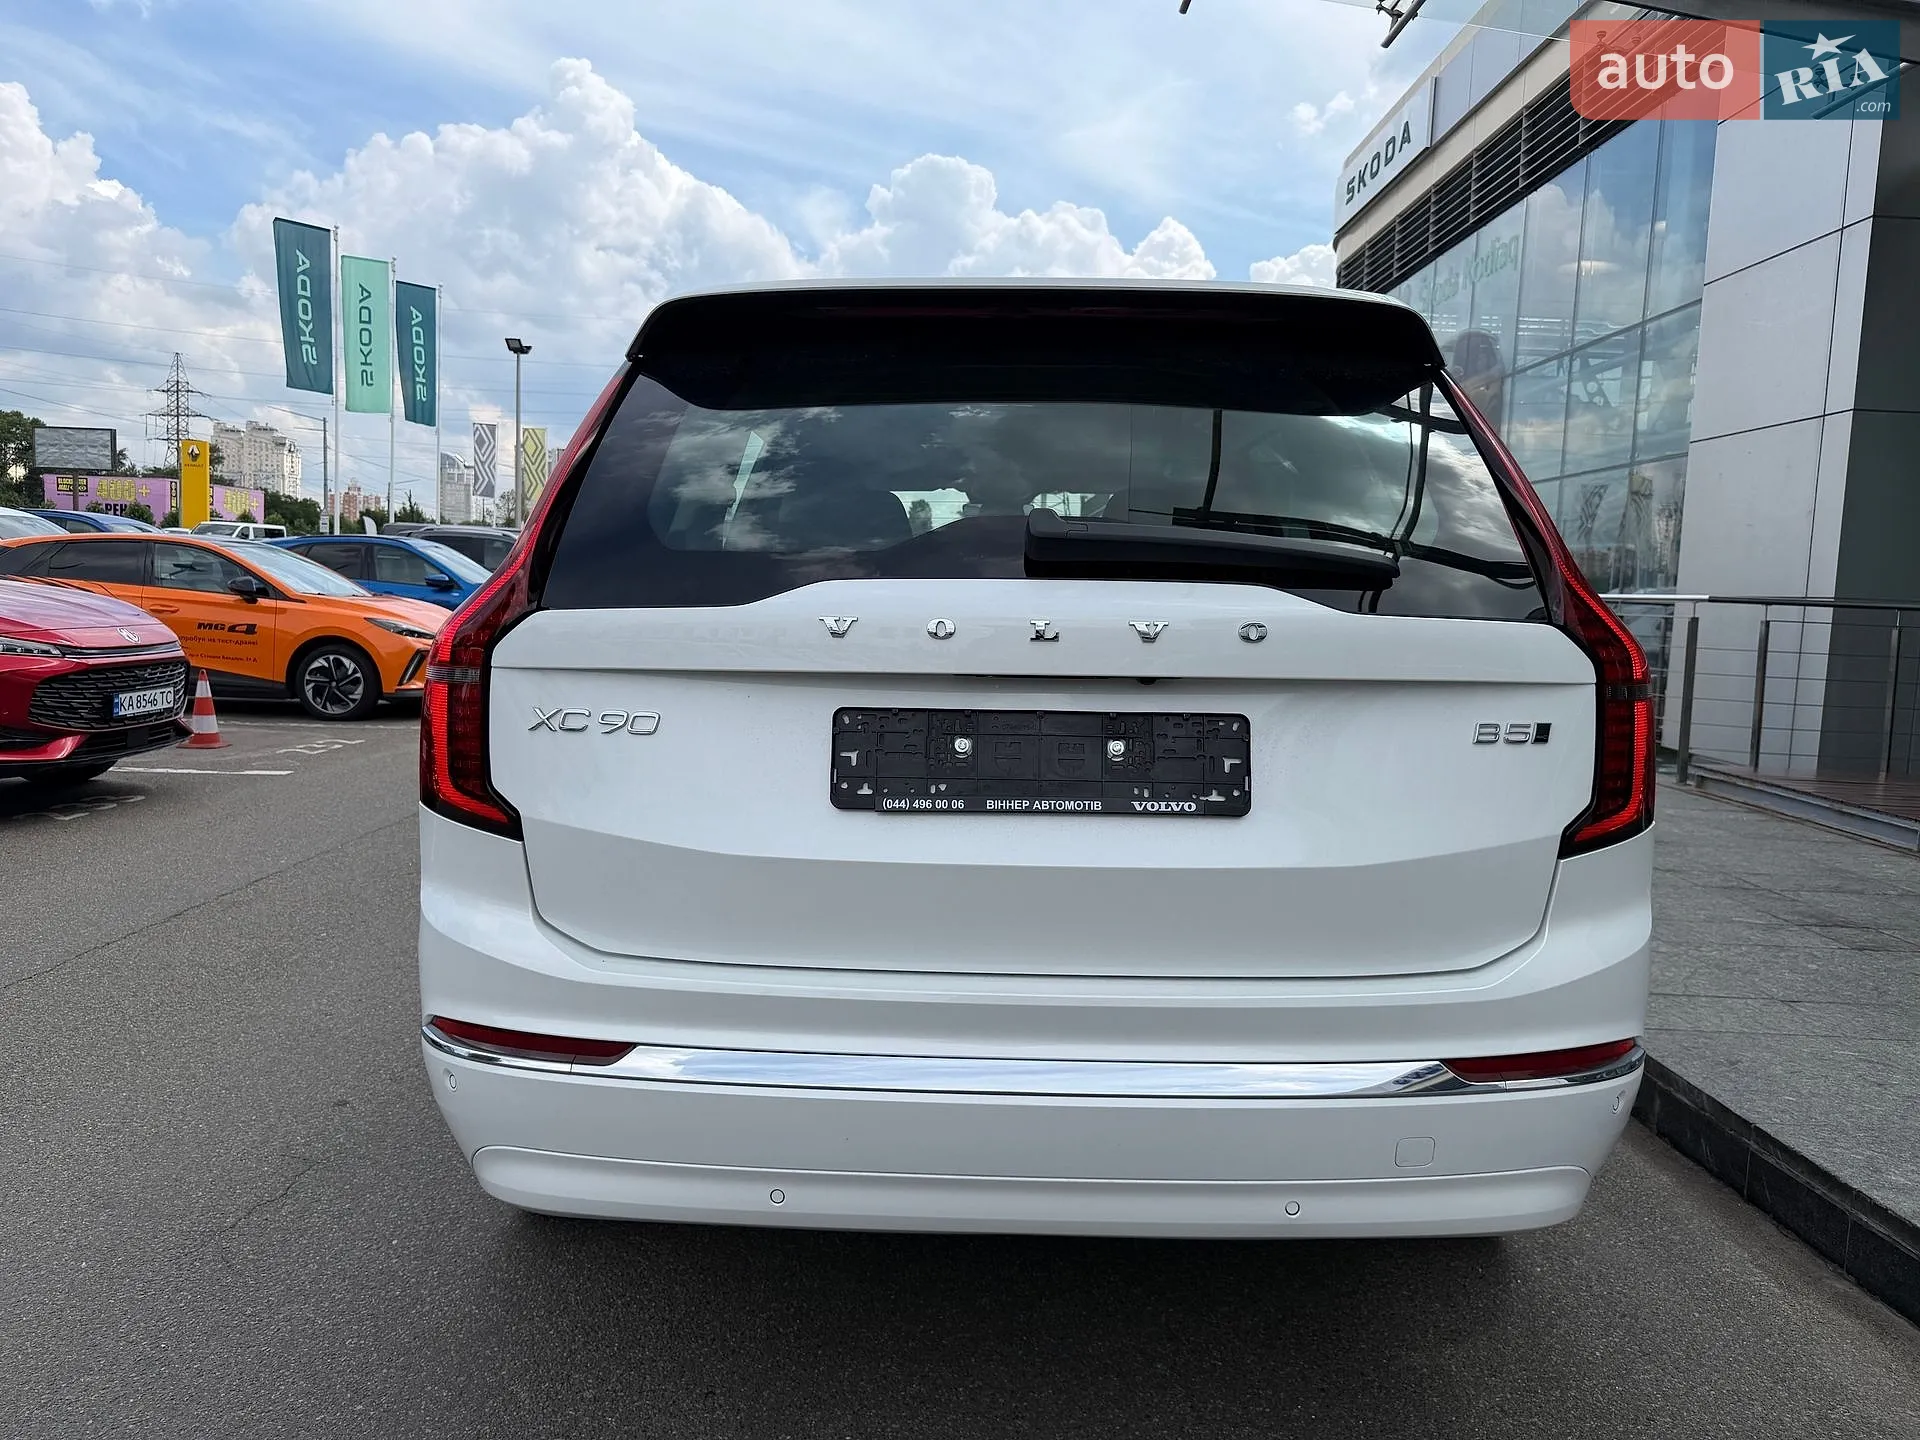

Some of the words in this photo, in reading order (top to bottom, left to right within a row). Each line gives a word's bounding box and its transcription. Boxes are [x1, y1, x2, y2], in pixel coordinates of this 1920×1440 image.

[818, 614, 1269, 643] VOLVO
[136, 692, 158, 709] 8546
[1472, 722, 1531, 744] B5
[882, 798, 910, 810] (044)
[912, 799, 932, 809] 496
[935, 799, 948, 809] 00
[951, 799, 965, 809] 06
[986, 800, 1030, 810] ВІННЕР
[1131, 801, 1197, 812] VOLVO
